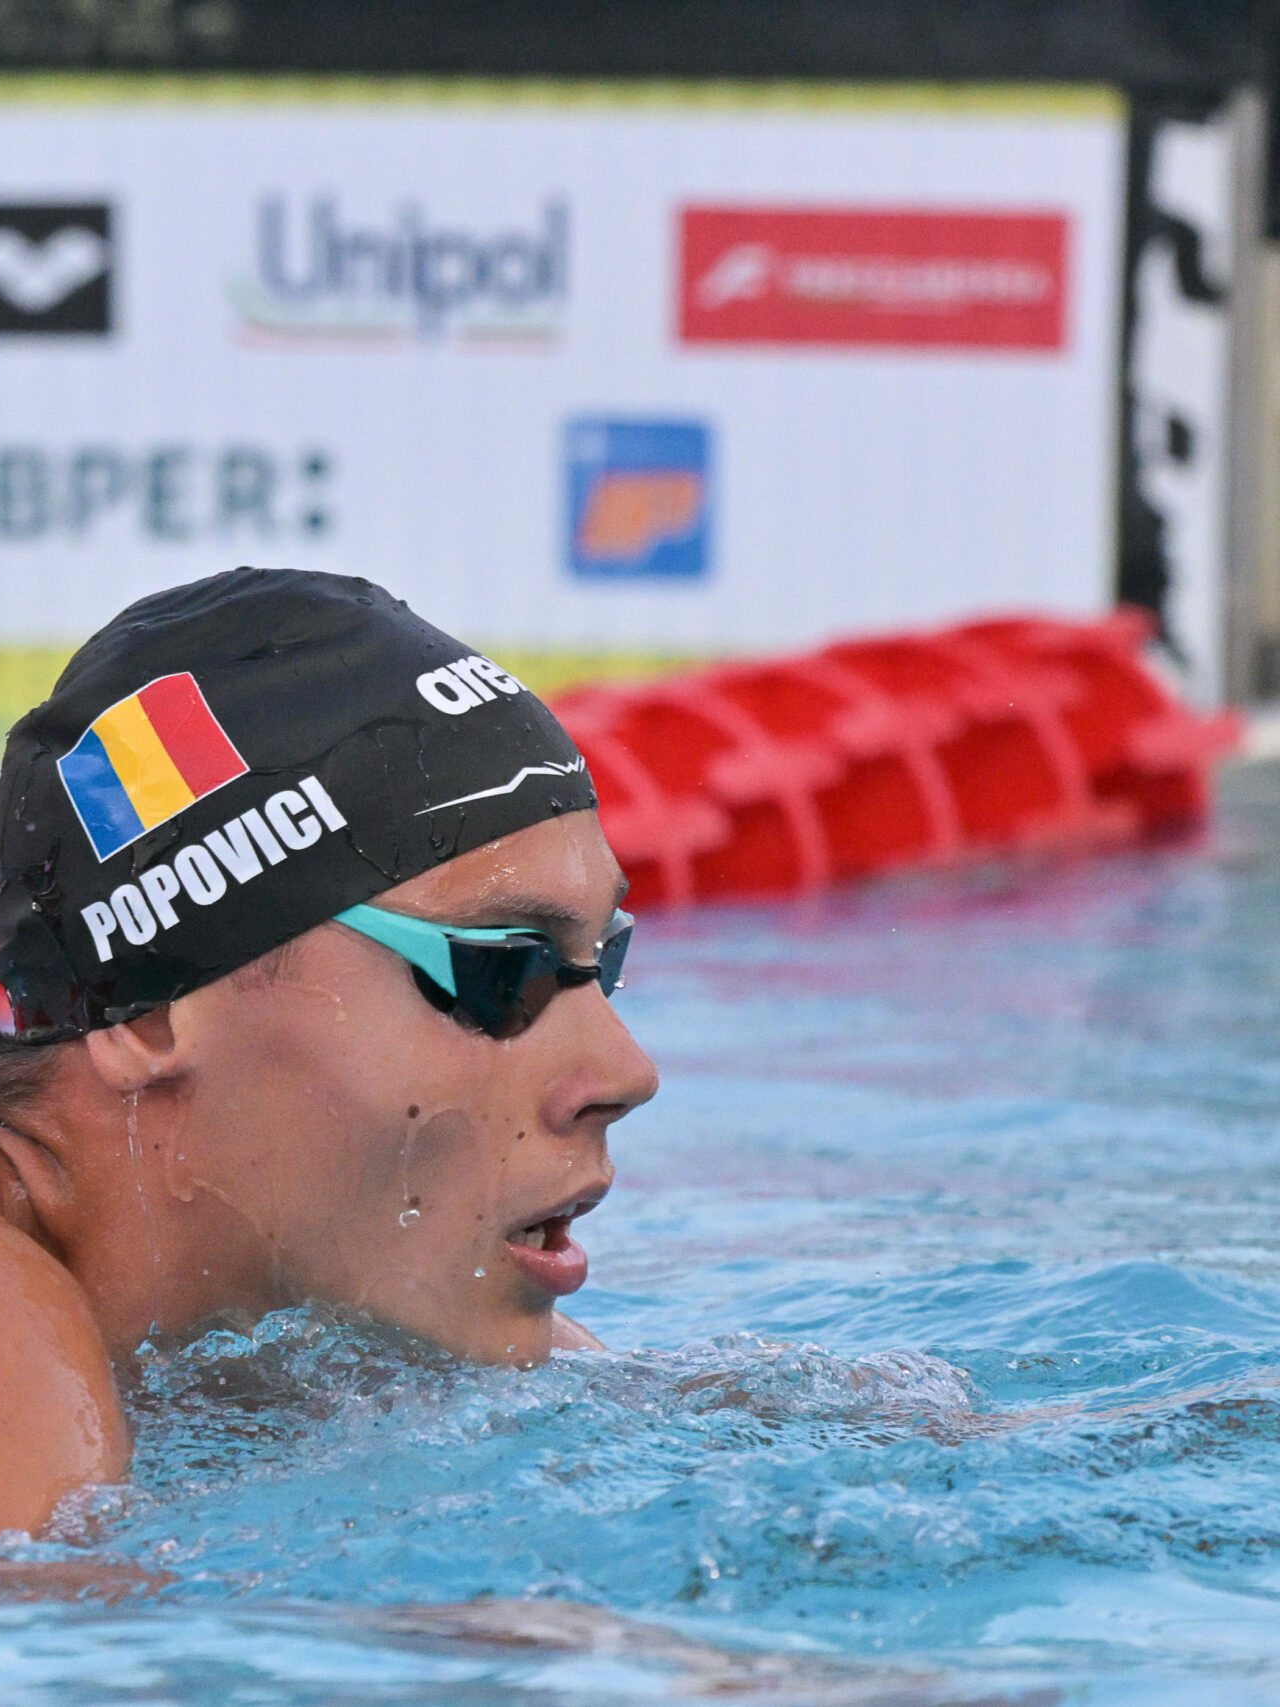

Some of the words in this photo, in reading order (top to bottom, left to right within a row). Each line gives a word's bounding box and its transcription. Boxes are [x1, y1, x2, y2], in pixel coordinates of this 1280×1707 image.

[257, 194, 569, 344] Unipol
[415, 655, 529, 716] are
[80, 775, 348, 963] POPOVICI
